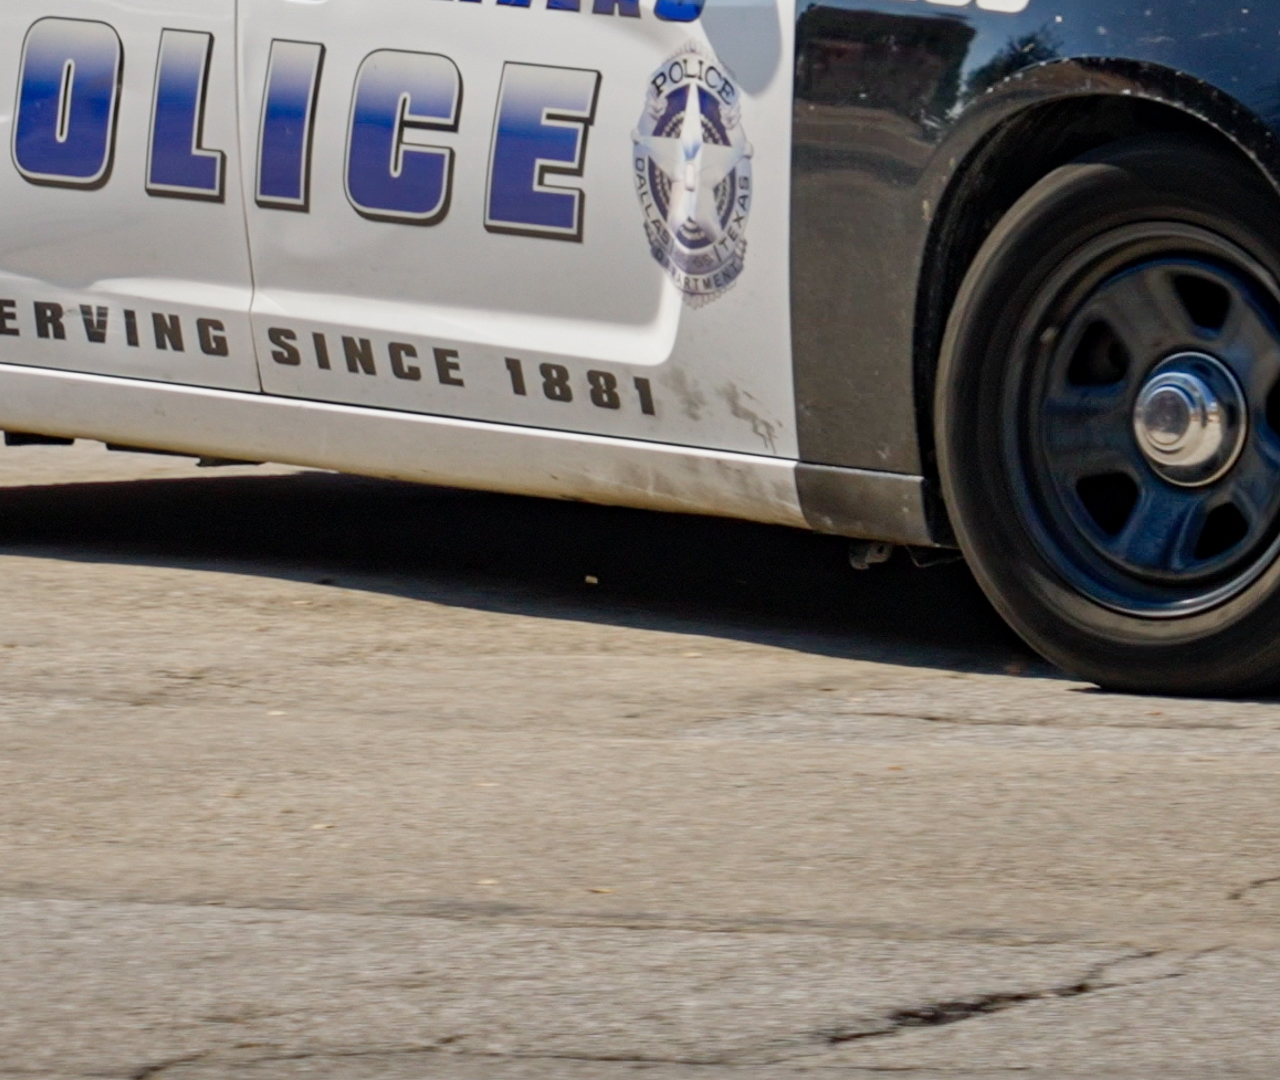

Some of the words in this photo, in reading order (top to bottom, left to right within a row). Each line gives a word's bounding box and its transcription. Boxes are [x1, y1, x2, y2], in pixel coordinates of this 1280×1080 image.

[651, 58, 735, 106] POLICE
[634, 157, 671, 246] DALLAS
[719, 176, 751, 252] TEXAS
[653, 247, 740, 292] DARTMENT
[267, 326, 466, 388] SINCE
[505, 356, 658, 417] 1881
